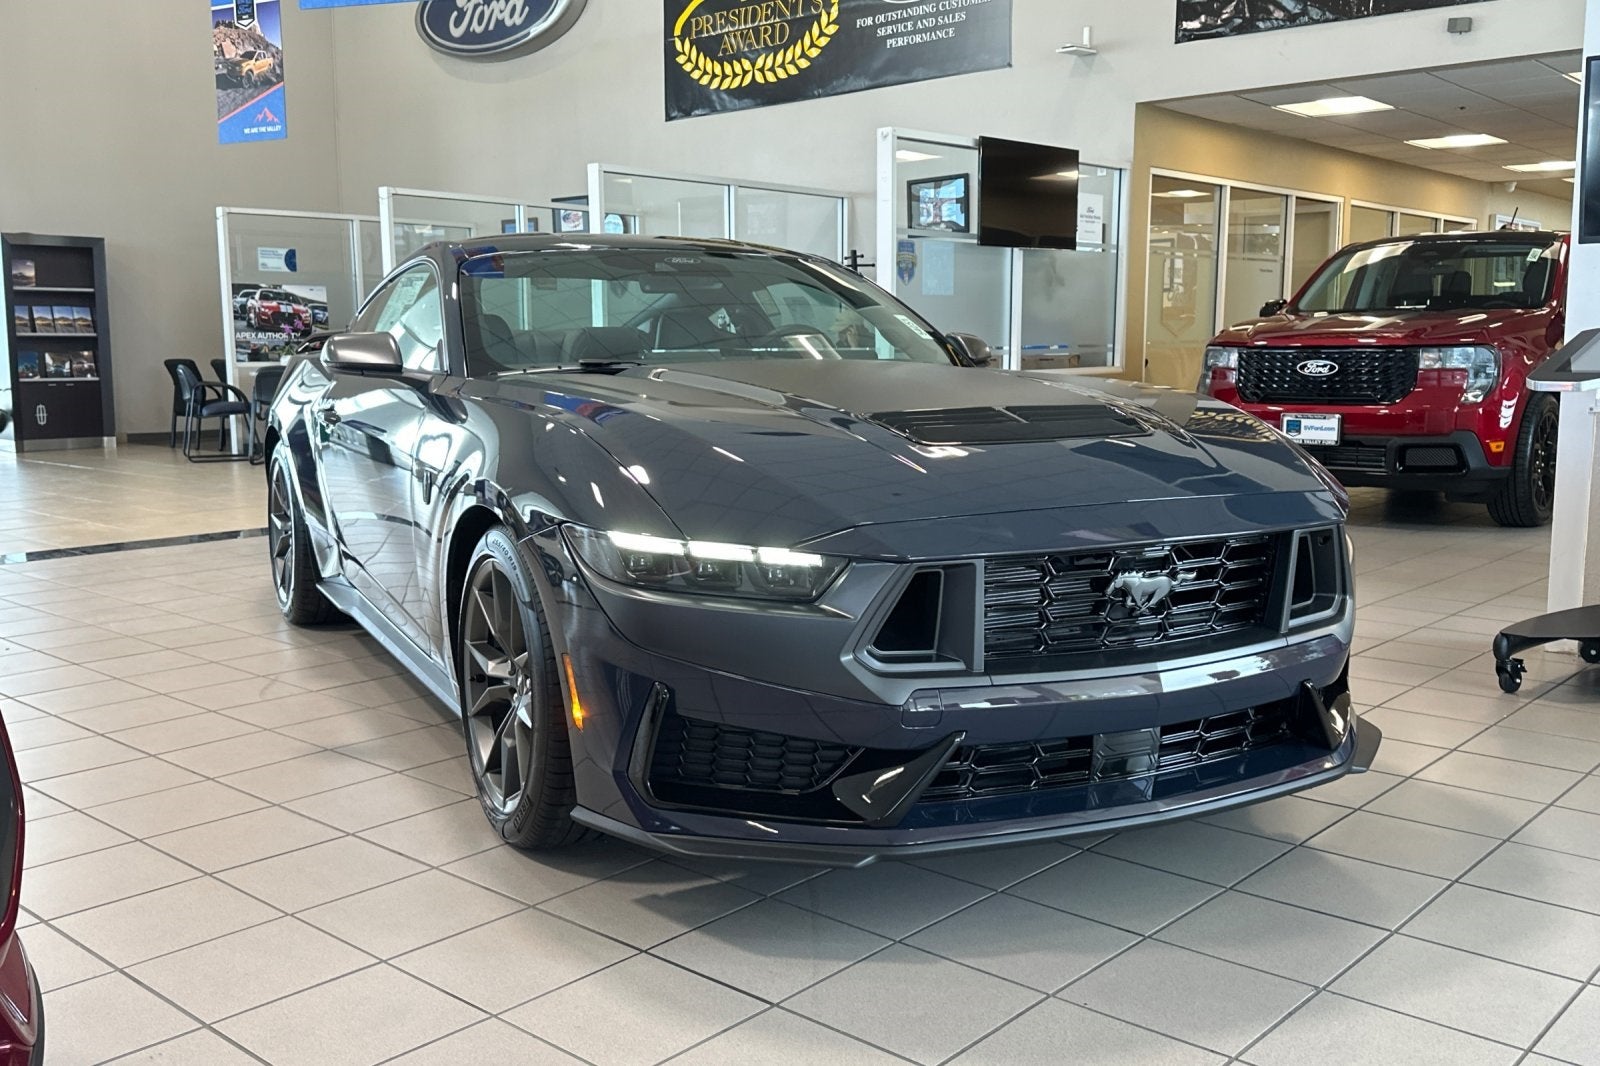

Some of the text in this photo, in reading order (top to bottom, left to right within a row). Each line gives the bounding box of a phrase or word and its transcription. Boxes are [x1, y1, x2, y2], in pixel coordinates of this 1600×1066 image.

[449, 0, 529, 38] Ford
[690, 0, 823, 39] PRESIDENTS
[856, 0, 992, 28] FOR OUTSTANDING CUSTOM
[876, 11, 966, 37] SERVICE AND SALES
[717, 22, 790, 57] AWARD
[886, 27, 956, 48] PERFORMANCE
[259, 332, 301, 340] AUTHORTY
[1304, 362, 1330, 374] Ford
